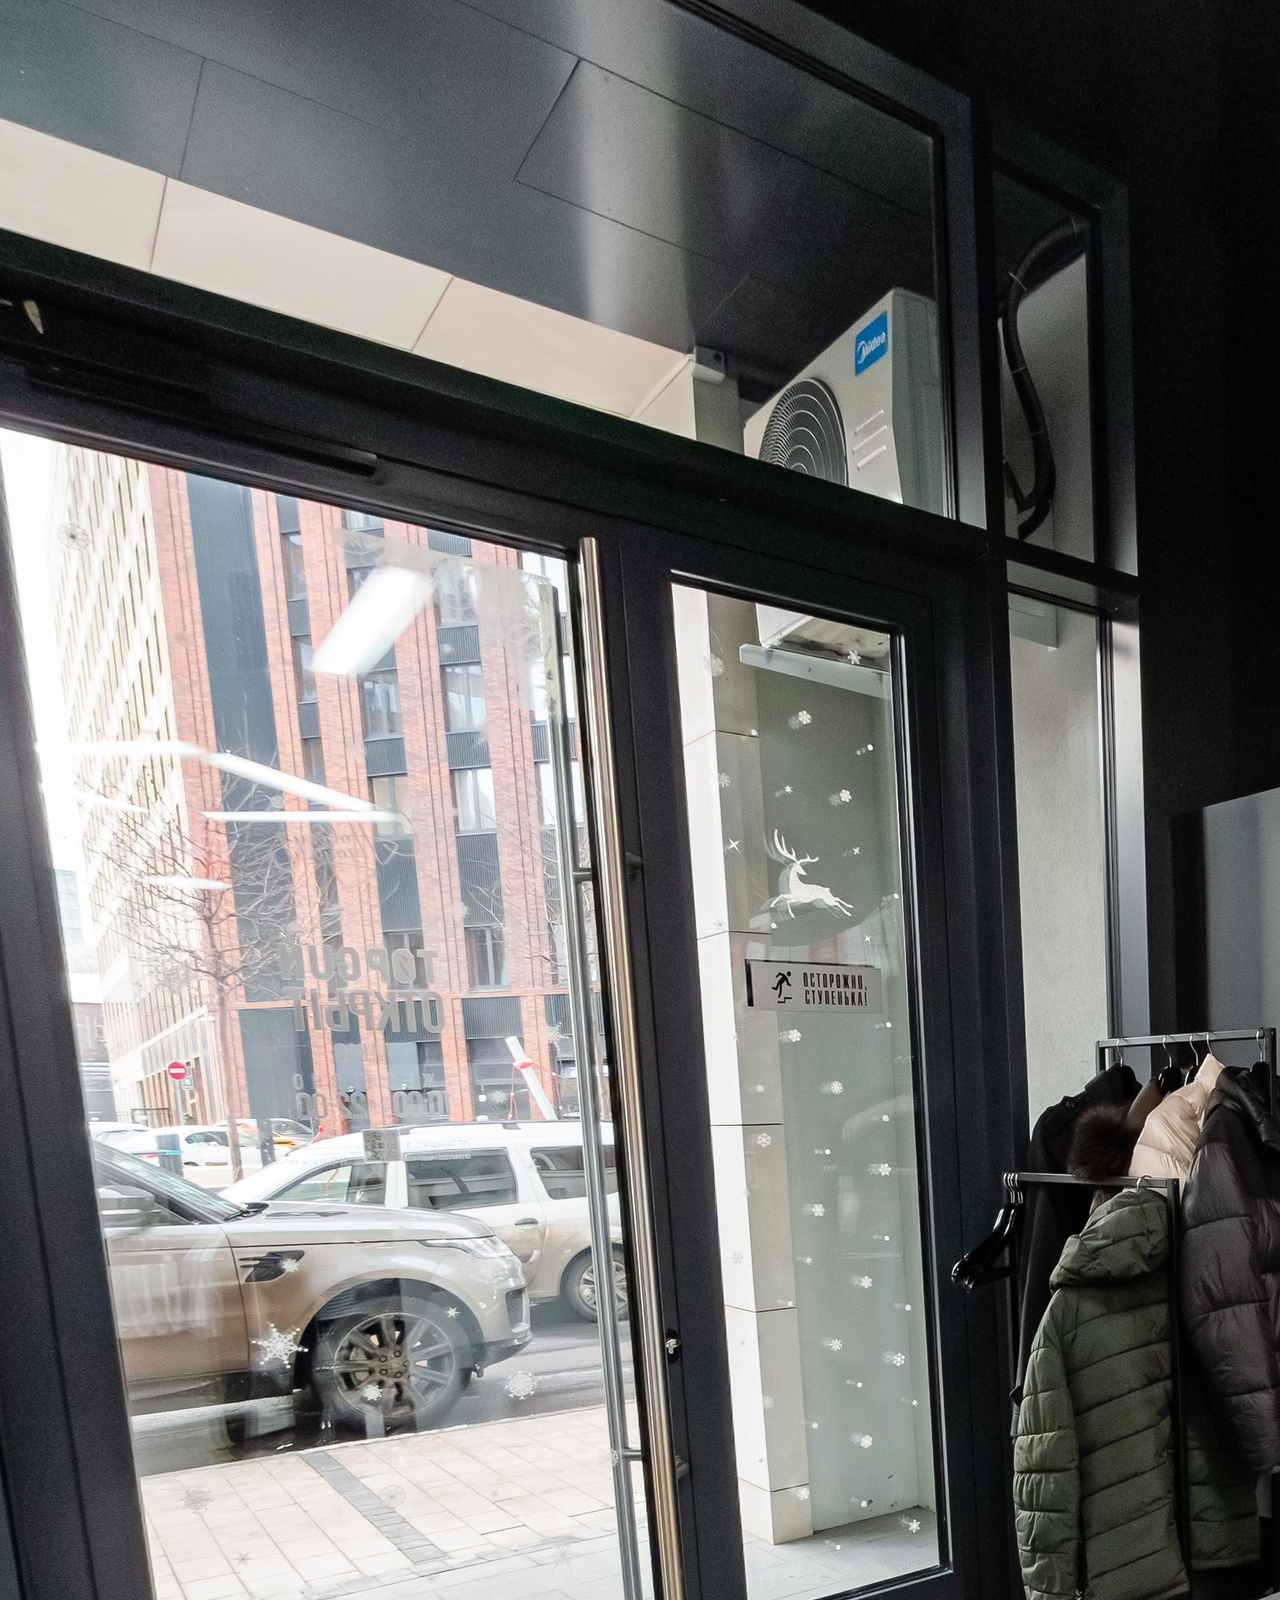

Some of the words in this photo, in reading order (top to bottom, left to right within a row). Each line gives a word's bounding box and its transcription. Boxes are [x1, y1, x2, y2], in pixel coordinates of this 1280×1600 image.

[857, 332, 886, 364] Midea
[803, 972, 868, 991] ОСТОРОЖНО,
[804, 990, 868, 1006] СТУПЕНЬКА!
